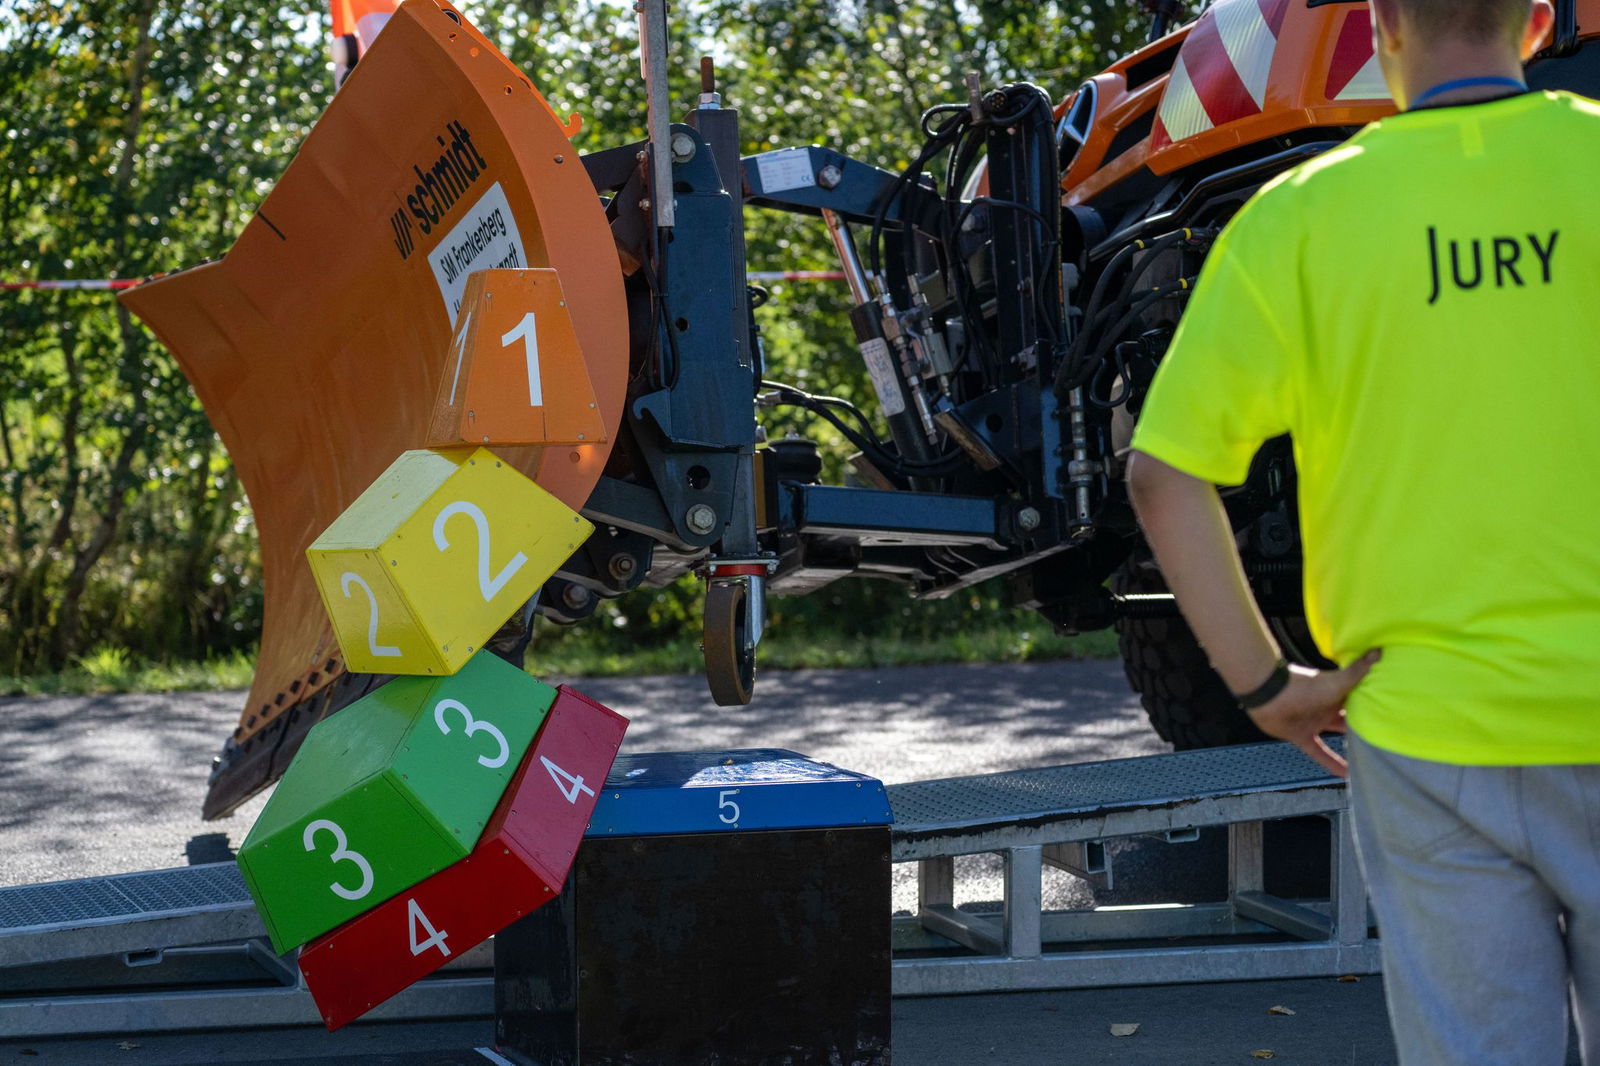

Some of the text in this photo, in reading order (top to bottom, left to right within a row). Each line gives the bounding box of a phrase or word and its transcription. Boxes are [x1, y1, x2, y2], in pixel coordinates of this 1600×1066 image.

[407, 120, 487, 235] schmidt
[451, 207, 507, 274] Frankenberg
[1427, 226, 1559, 305] JURY
[450, 311, 471, 406] 1
[501, 312, 543, 406] 1
[432, 501, 528, 602] 2
[341, 571, 403, 657] 2
[434, 699, 510, 769] 3
[540, 755, 595, 804] 4
[718, 790, 740, 824] 5
[303, 819, 374, 900] 3
[408, 898, 452, 957] 4
